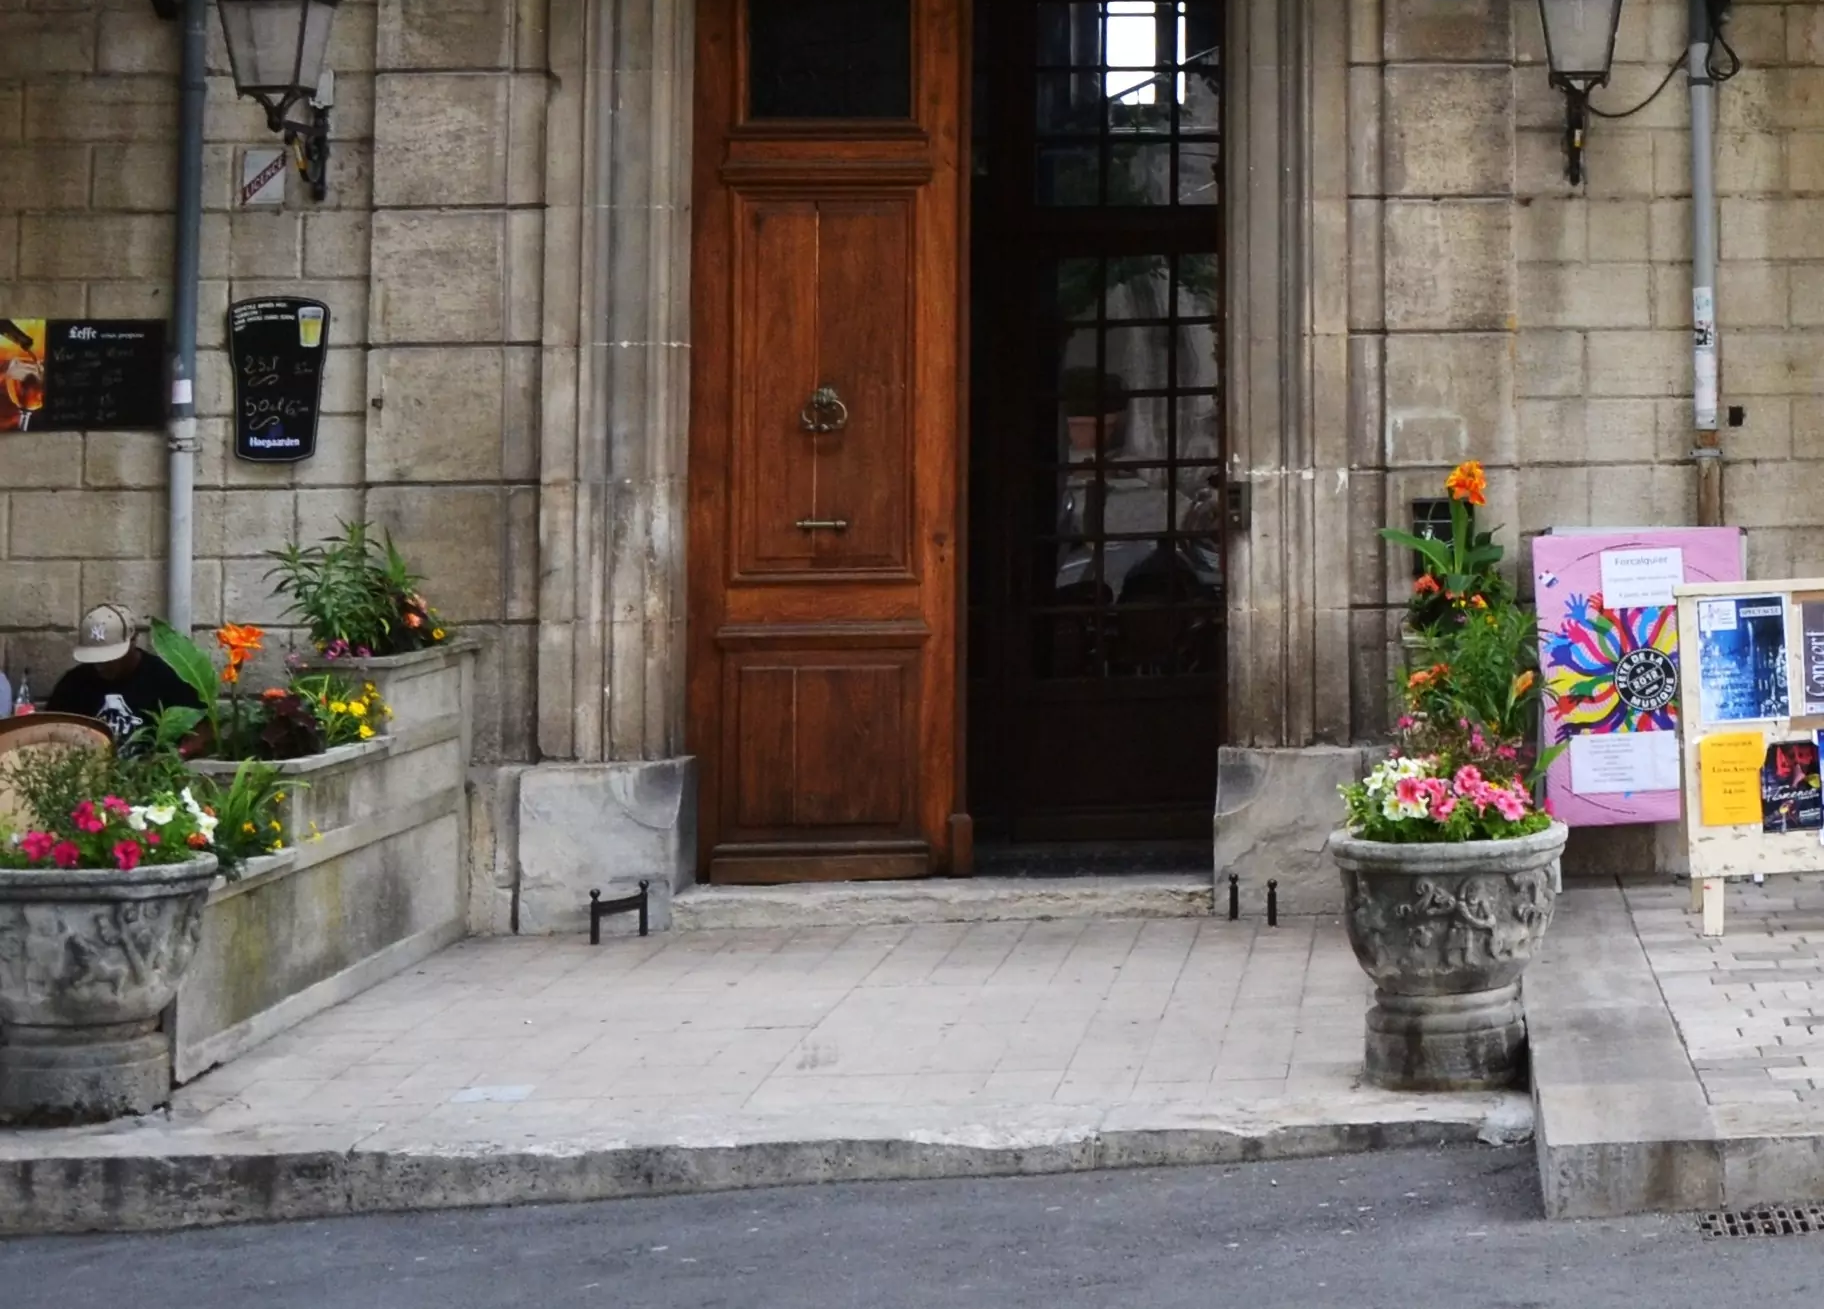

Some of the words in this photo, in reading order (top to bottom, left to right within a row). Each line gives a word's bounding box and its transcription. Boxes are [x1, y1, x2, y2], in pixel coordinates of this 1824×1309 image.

[69, 325, 97, 340] Leffe
[1614, 556, 1668, 566] Forcalquier
[1631, 652, 1646, 664] DE
[1649, 653, 1664, 666] LA
[1630, 677, 1675, 708] MUSIQUE
